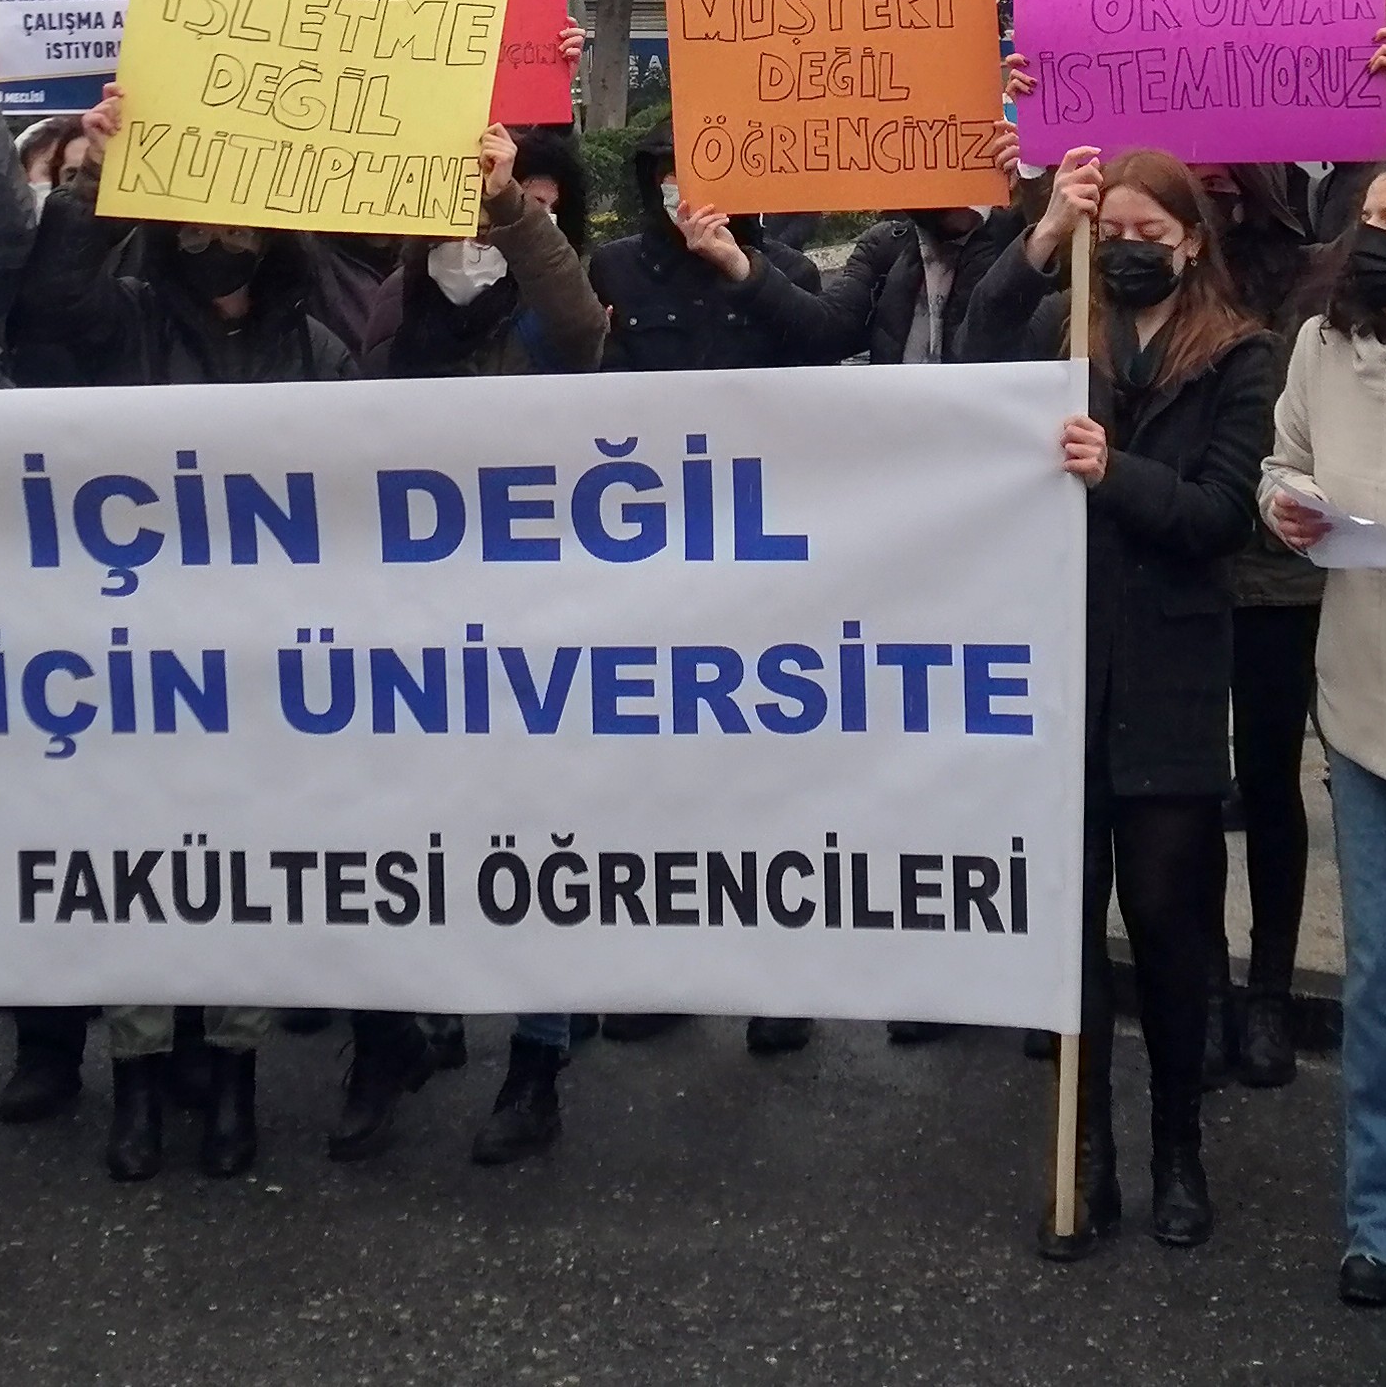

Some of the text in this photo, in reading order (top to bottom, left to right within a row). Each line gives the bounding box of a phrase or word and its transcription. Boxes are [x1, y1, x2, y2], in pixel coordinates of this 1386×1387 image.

[23, 12, 105, 36] ÇALIŞMA
[201, 53, 401, 137] DEĞİL
[758, 47, 911, 102] DEĞİL
[1038, 40, 1383, 126] İSTEMİYORUZ
[117, 121, 483, 227] KÜTÜPHANE
[691, 113, 998, 182] ÖĞRENCİYİZ
[22, 450, 319, 596] İÇİN
[377, 434, 808, 562] DEĞİL
[278, 621, 1033, 735] ÜNİVERSİTE
[18, 833, 445, 926] FAKÜLTESİ
[478, 832, 1027, 933] ÖĞRENCİLERİ
